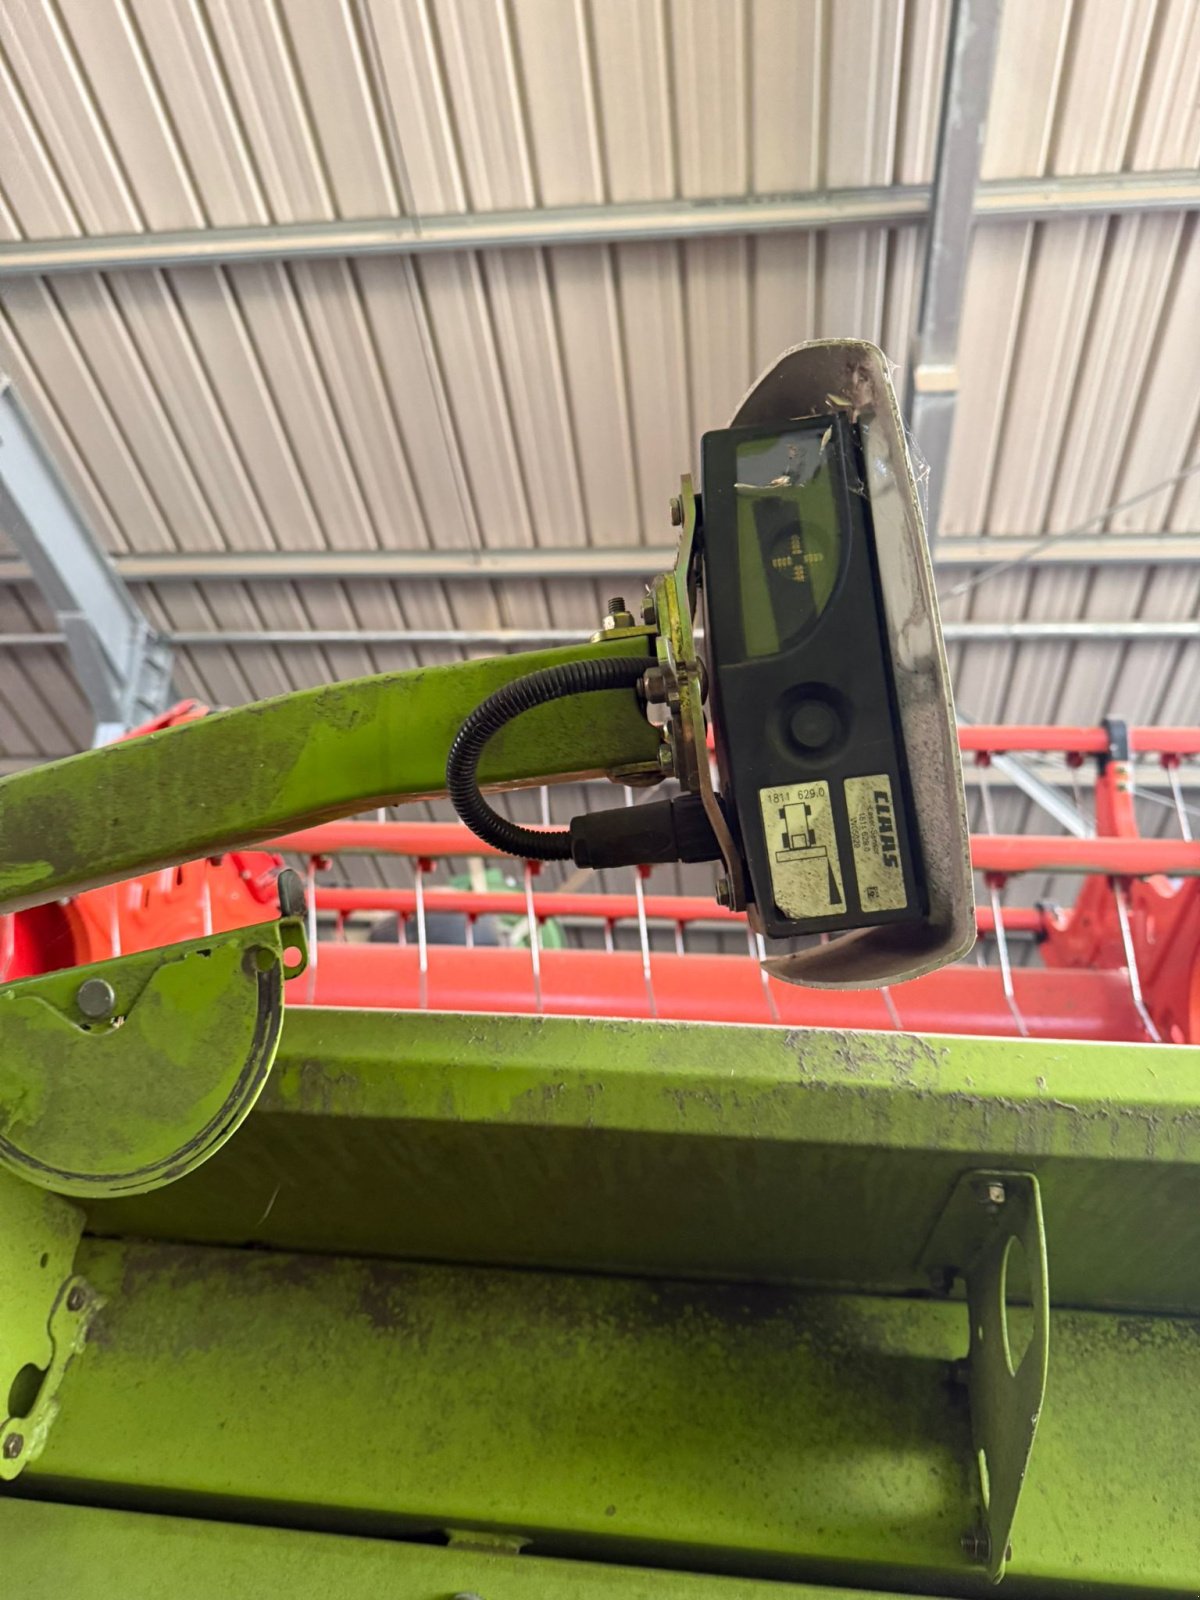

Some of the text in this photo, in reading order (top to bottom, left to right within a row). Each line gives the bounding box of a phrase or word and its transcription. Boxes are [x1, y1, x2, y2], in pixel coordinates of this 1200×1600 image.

[767, 787, 825, 803] 1811 629.0
[874, 791, 898, 868] CLAAS
